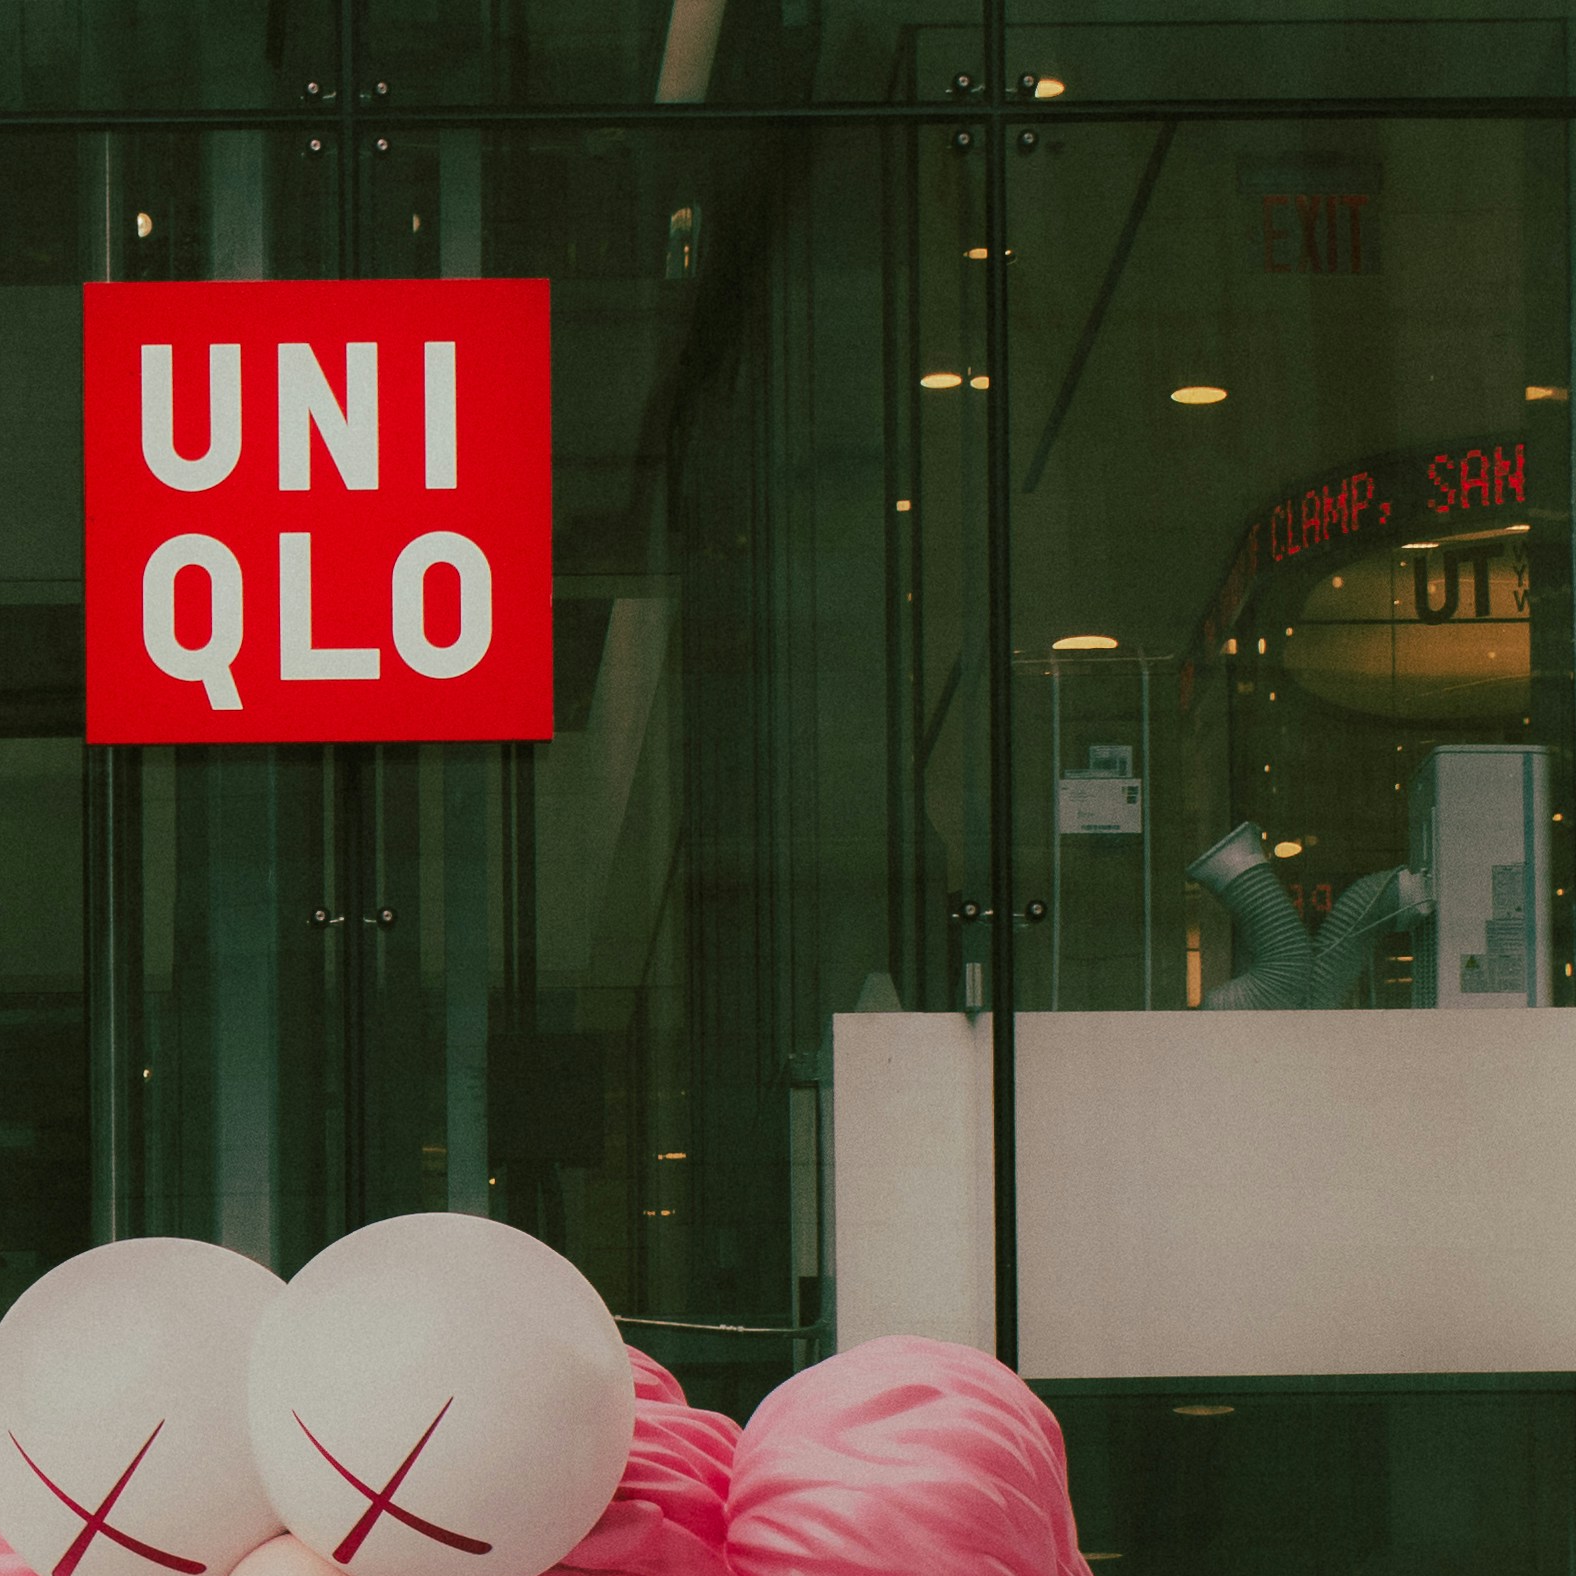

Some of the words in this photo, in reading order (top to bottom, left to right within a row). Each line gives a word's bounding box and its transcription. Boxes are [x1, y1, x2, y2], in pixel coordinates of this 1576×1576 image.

[1263, 194, 1369, 273] EXIT
[140, 341, 458, 492] UNI
[1271, 471, 1392, 563] CLAMP,
[142, 531, 493, 712] QLO
[1413, 544, 1505, 626] UT
